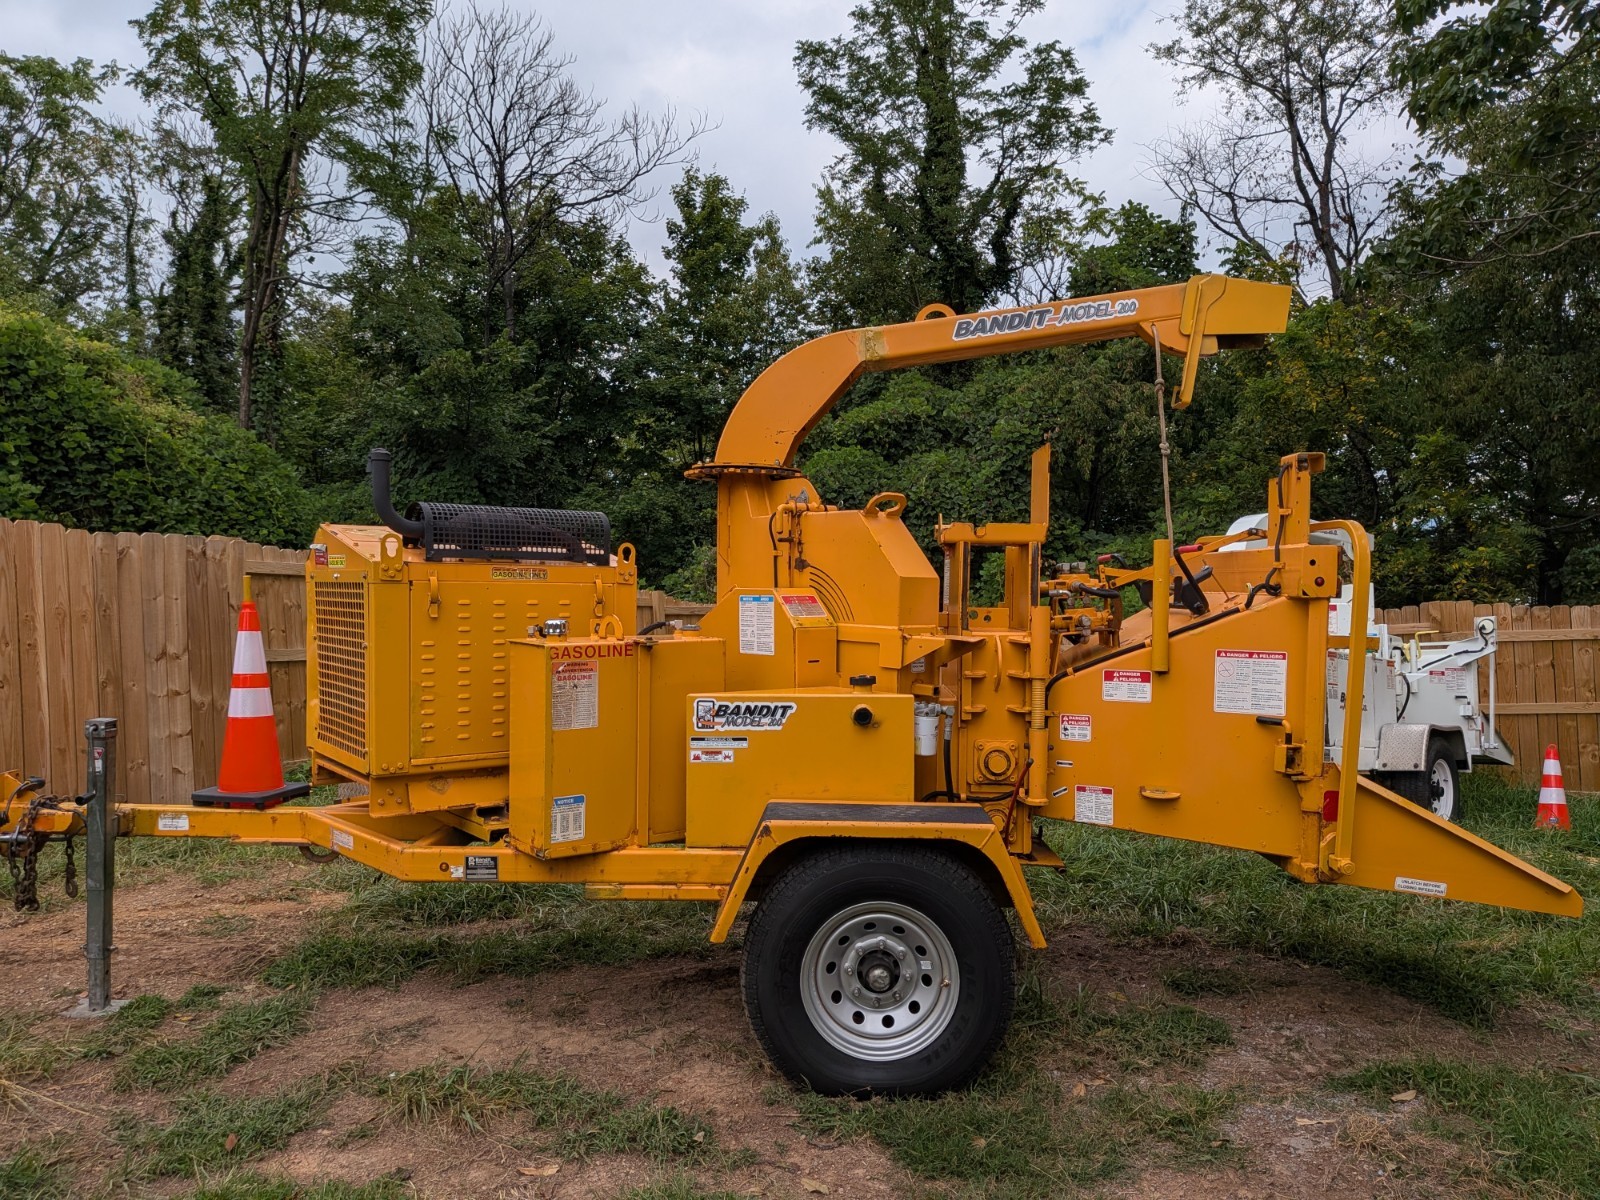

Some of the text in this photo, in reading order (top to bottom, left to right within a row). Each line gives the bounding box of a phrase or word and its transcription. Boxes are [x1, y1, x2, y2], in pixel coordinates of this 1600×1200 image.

[954, 299, 1137, 340] BANDIT MODEL 200
[549, 643, 634, 660] GASOLINE
[714, 704, 795, 719] BANDIT
[721, 716, 783, 728] MODEL 200
